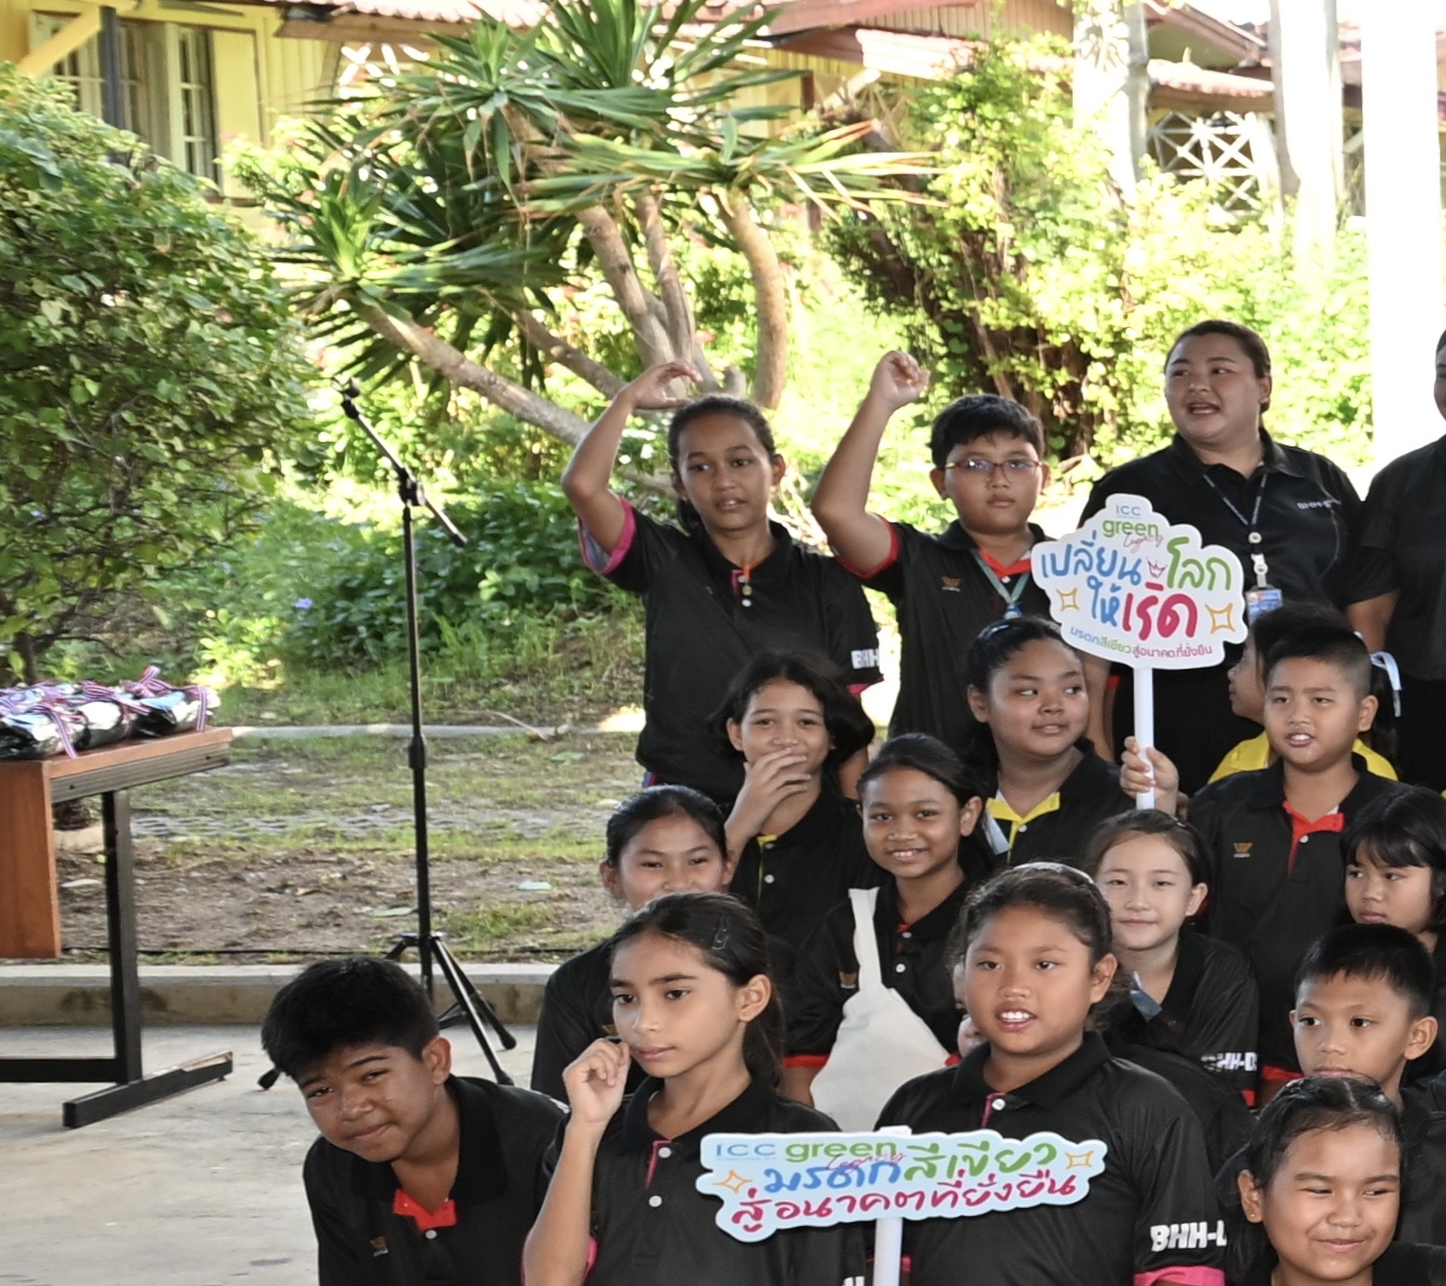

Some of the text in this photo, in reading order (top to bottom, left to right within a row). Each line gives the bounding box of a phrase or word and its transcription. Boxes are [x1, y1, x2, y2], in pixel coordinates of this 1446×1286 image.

[1102, 519, 1158, 538] green
[1116, 505, 1141, 517] ICC
[1041, 530, 1232, 591] เปลี่ยน โลก
[716, 1141, 897, 1163] ICC green
[764, 1140, 1058, 1194] มรดกสีเขียว
[731, 1168, 1077, 1233] สู่อนาคตที่ยั่งยืน
